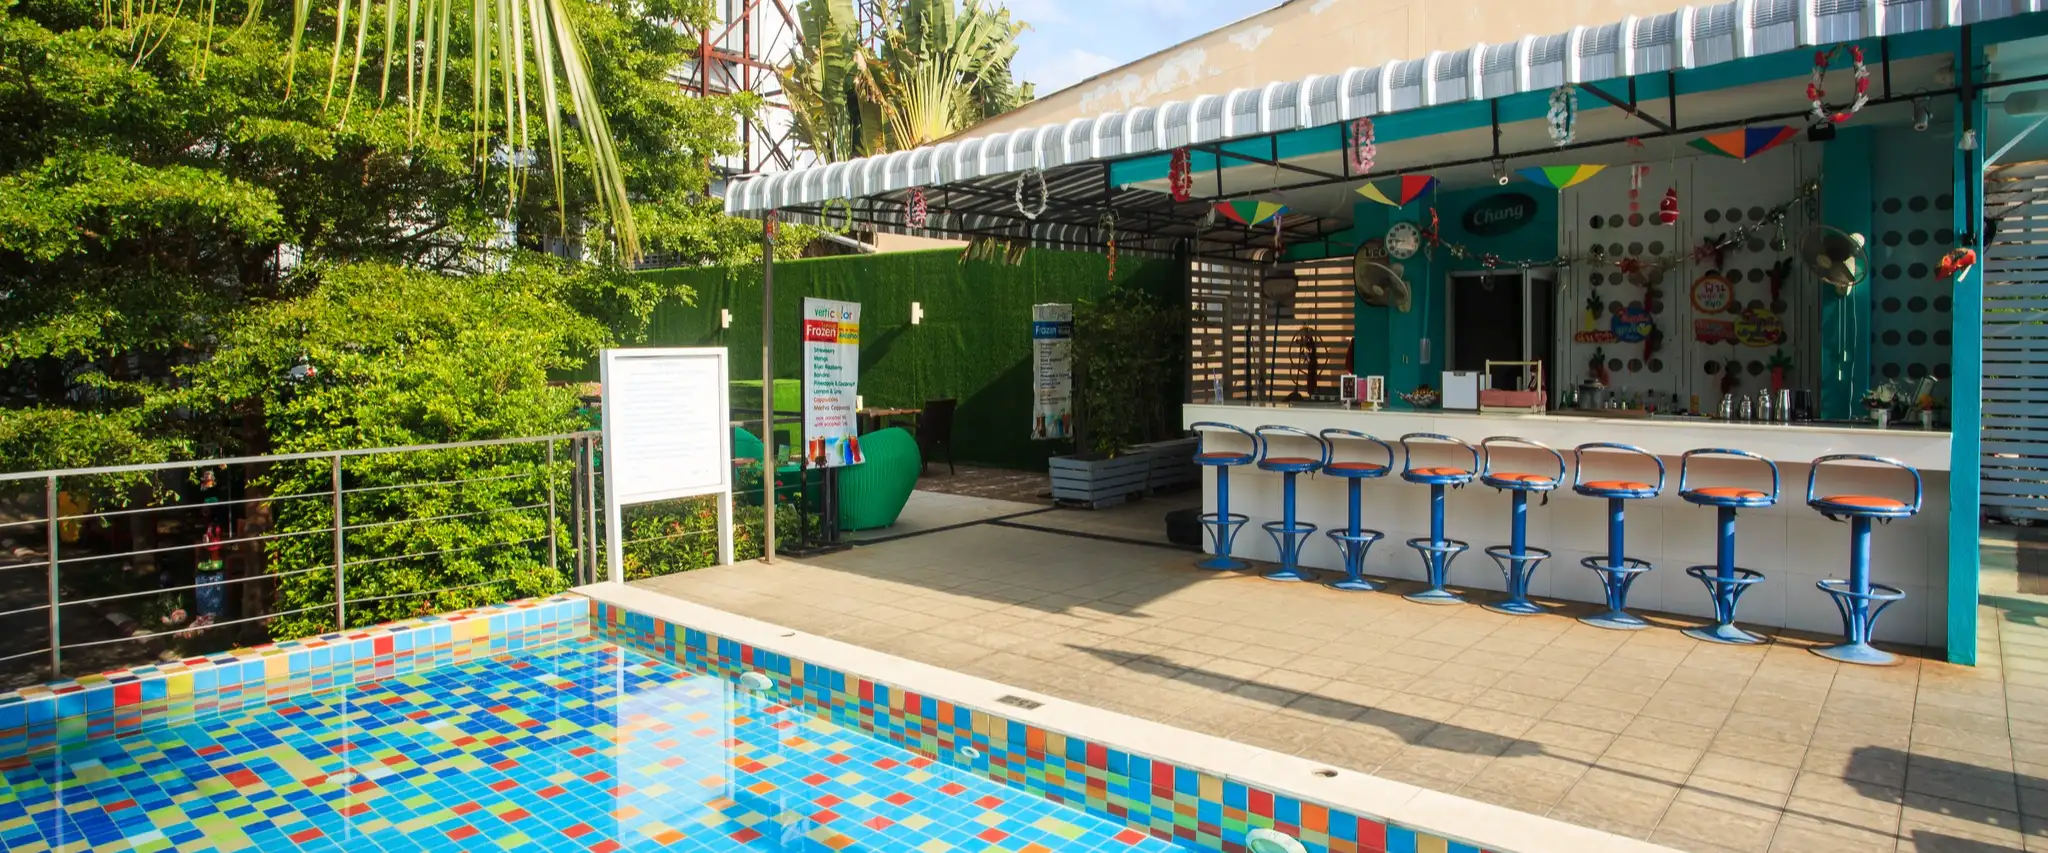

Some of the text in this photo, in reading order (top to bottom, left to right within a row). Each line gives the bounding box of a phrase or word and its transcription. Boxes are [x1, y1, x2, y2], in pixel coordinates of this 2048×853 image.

[1472, 203, 1525, 226] Chang
[1363, 247, 1388, 259] LEO
[806, 324, 837, 338] Frozen
